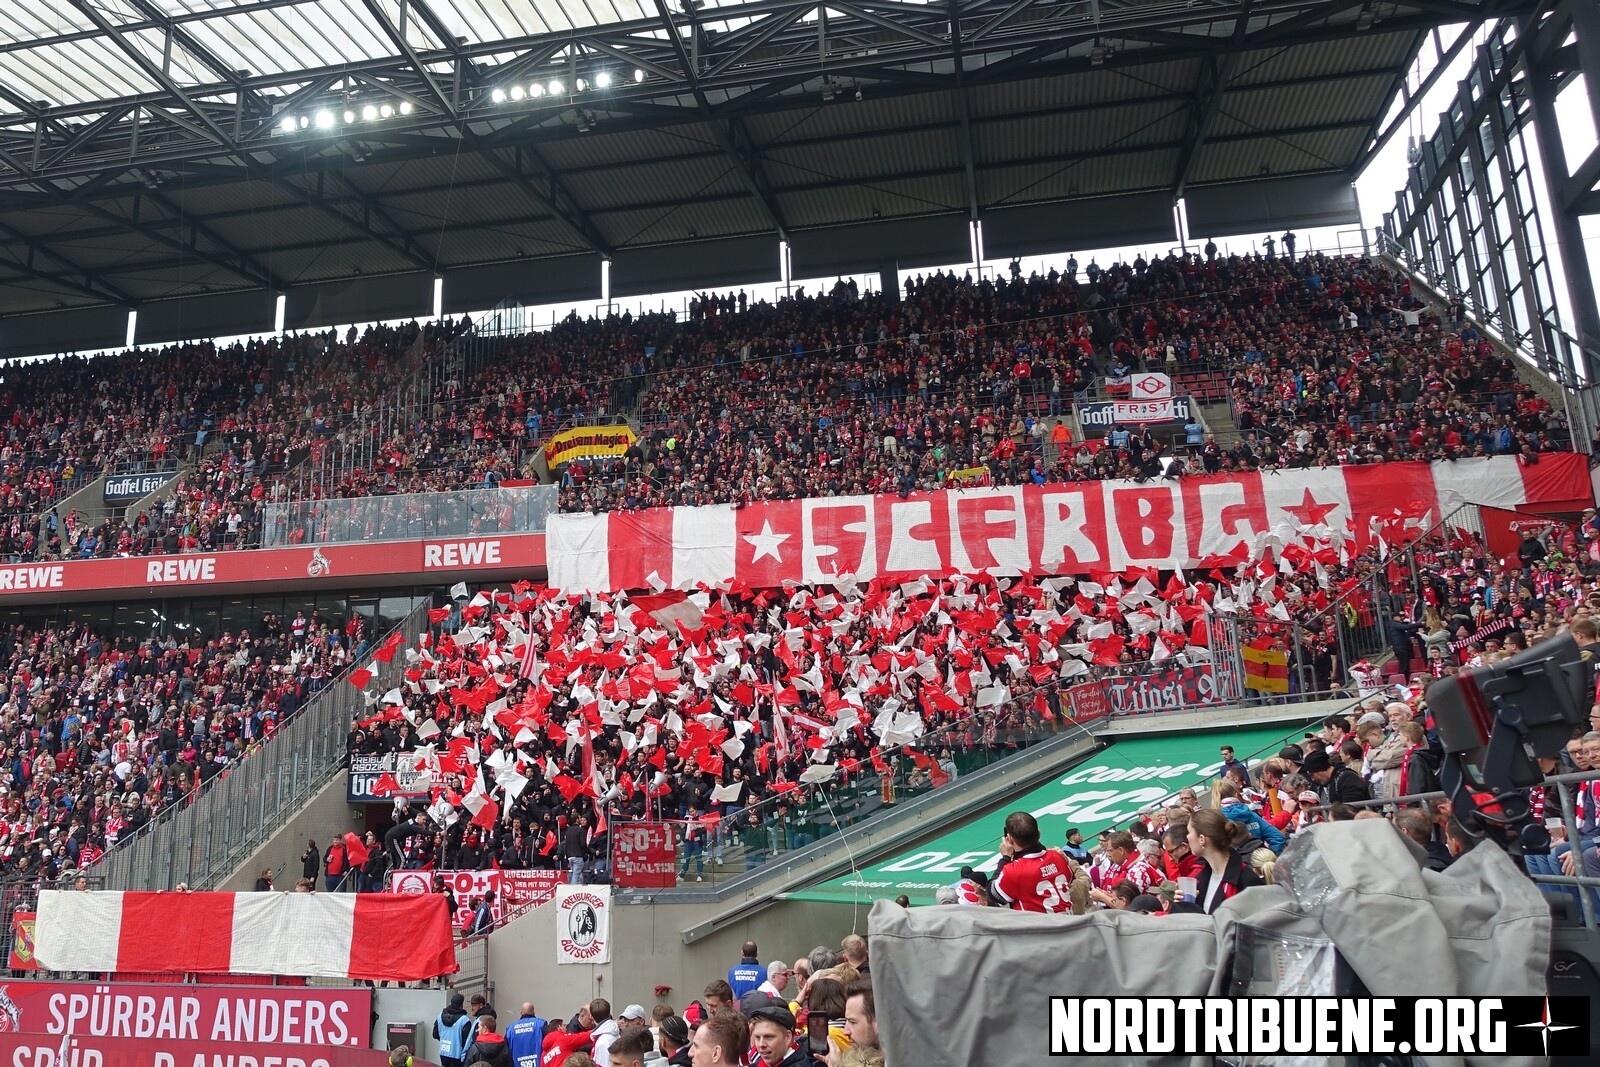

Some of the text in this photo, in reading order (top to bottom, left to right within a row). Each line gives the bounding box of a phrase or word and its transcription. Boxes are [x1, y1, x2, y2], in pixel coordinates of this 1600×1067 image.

[105, 478, 140, 495] Gaffel
[424, 541, 501, 567] REWE
[147, 558, 216, 582] REWE
[1111, 670, 1232, 715] Tifosi 97
[1061, 763, 1199, 785] Come
[1040, 863, 1058, 878] JEONG
[561, 892, 605, 910] FREIBURGER
[561, 939, 605, 959] BOTSCHAFT
[47, 986, 358, 1045] SPÜRBAR ANDERS.
[514, 1021, 535, 1030] SECURITY
[543, 1046, 562, 1065] REWE
